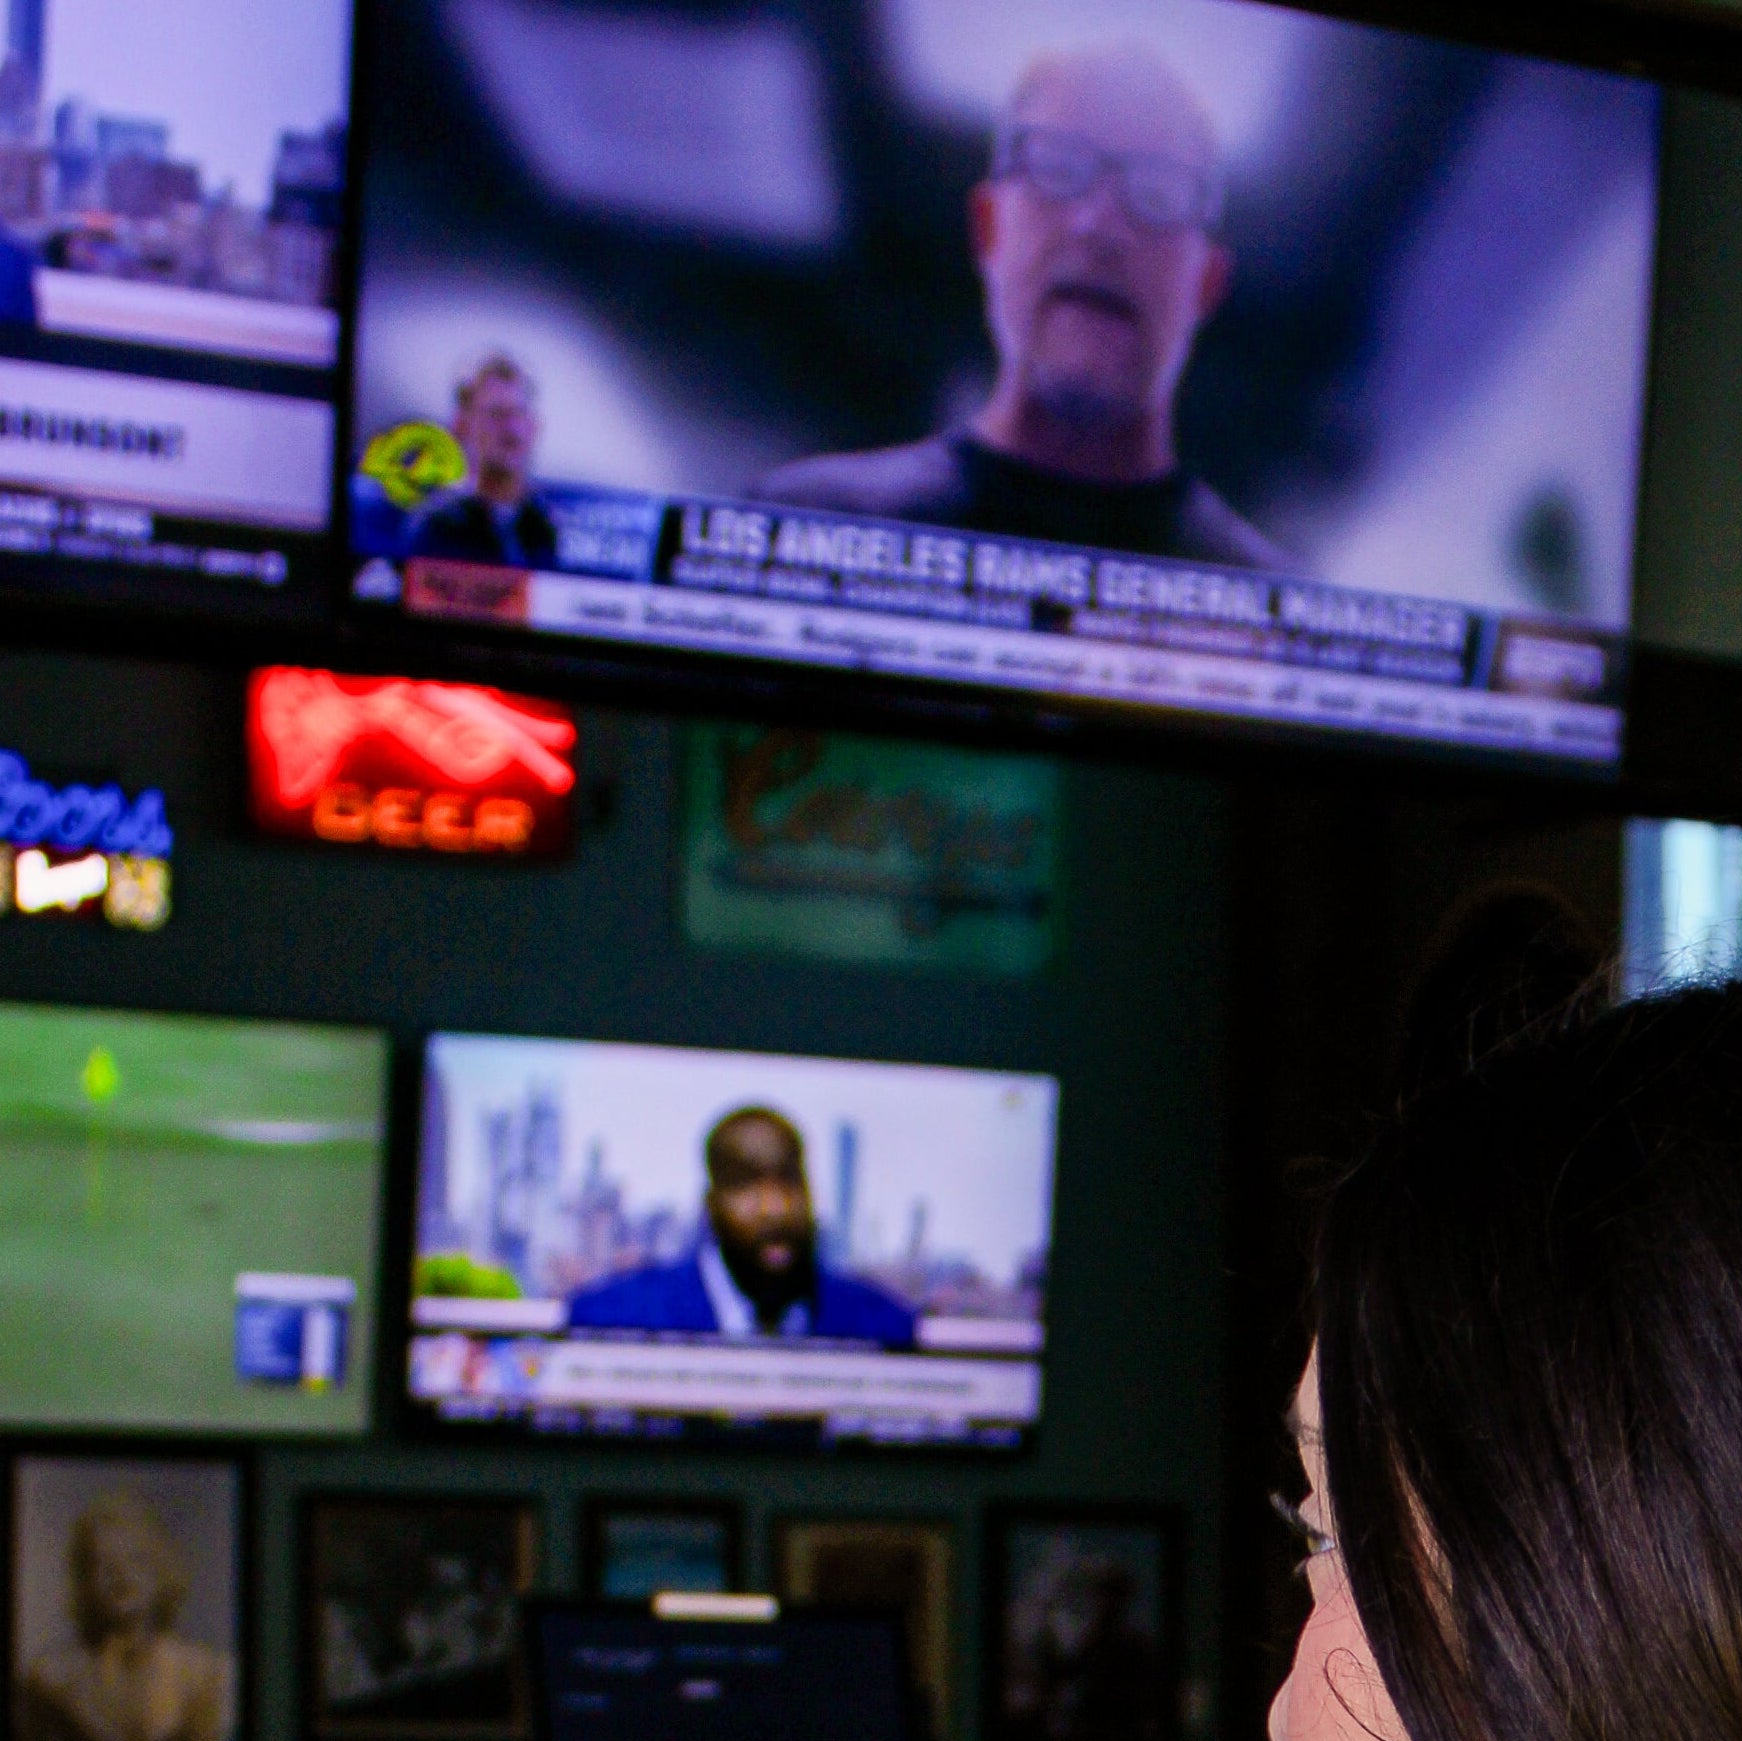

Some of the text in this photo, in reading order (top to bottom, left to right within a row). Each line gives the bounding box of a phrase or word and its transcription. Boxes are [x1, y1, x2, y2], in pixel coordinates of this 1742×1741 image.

[774, 515, 967, 585] ANGELES
[1100, 559, 1272, 626] GENERAL
[1277, 585, 1465, 650] MANAGER
